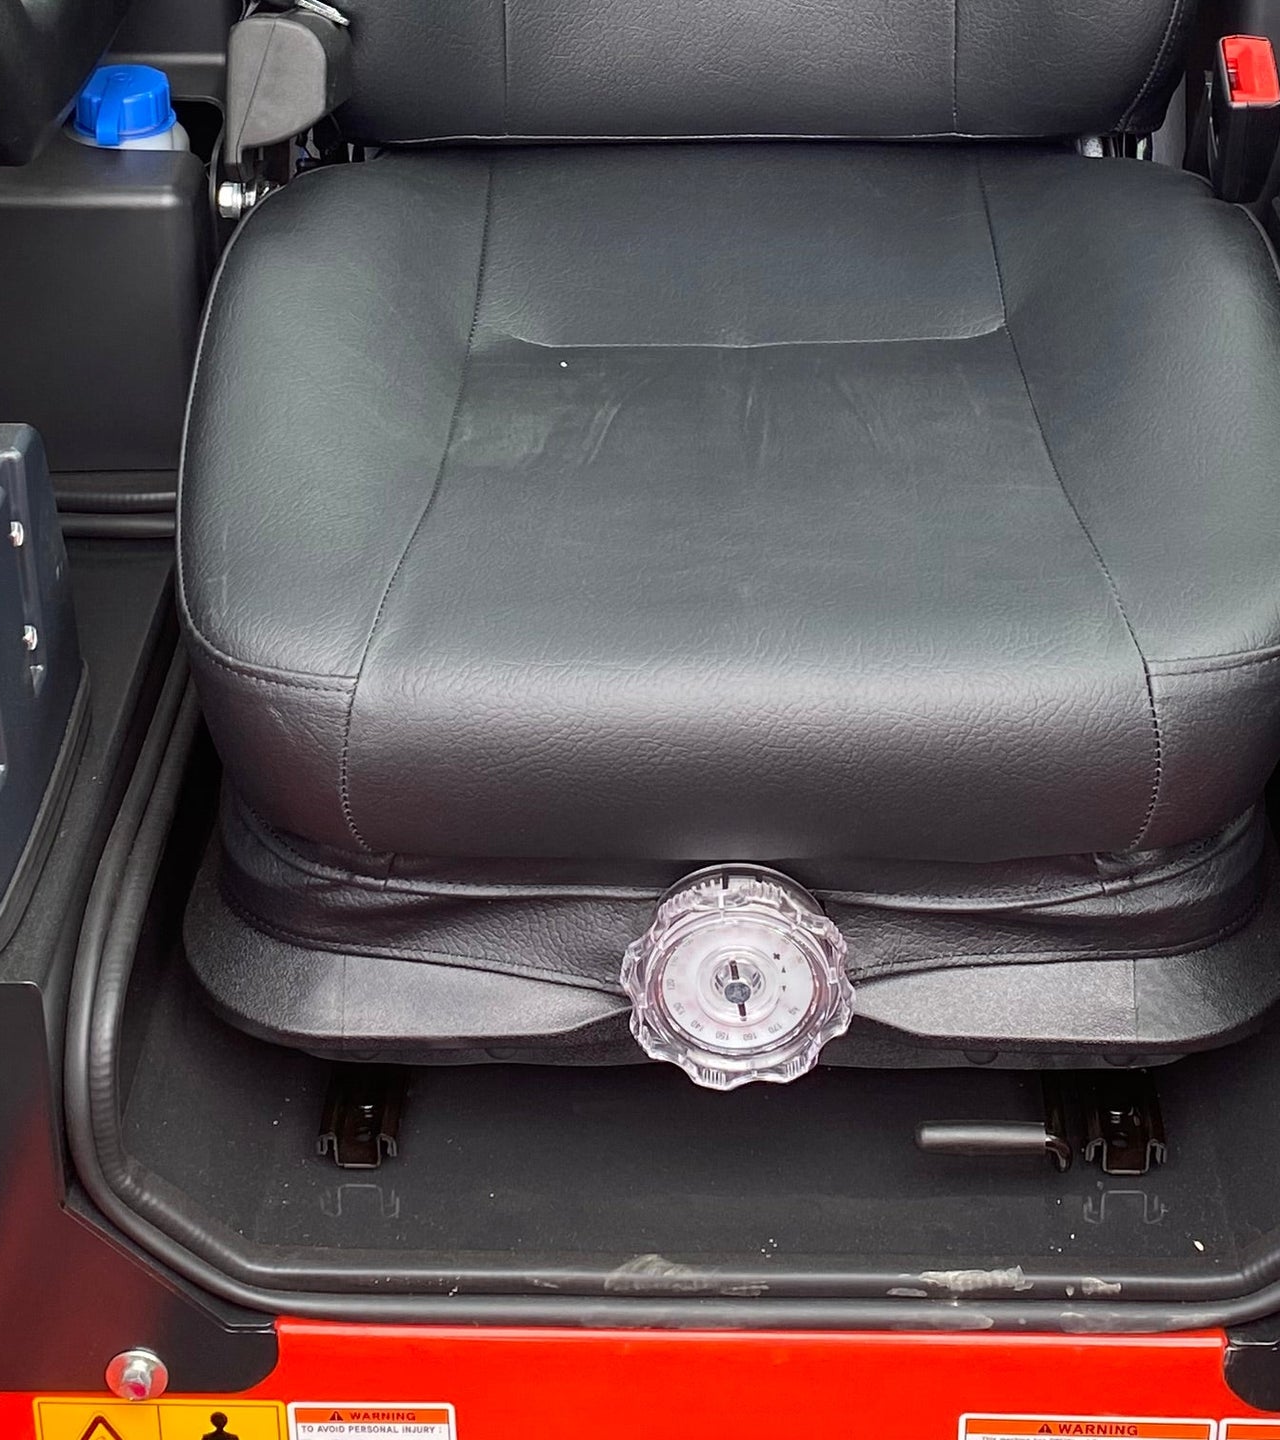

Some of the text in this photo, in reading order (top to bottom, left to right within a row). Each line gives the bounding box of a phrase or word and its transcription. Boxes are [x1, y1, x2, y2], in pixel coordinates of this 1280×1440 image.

[690, 1020, 705, 1032] 140
[767, 1022, 783, 1034] 170
[715, 1030, 730, 1040] 150
[742, 1032, 757, 1041] 160
[349, 1411, 416, 1421] WARNING
[301, 1425, 314, 1433] TO
[317, 1425, 345, 1433] AVOID
[348, 1426, 399, 1434] PERSONAL
[402, 1426, 435, 1434] INJURY
[1058, 1423, 1138, 1436] WARNING
